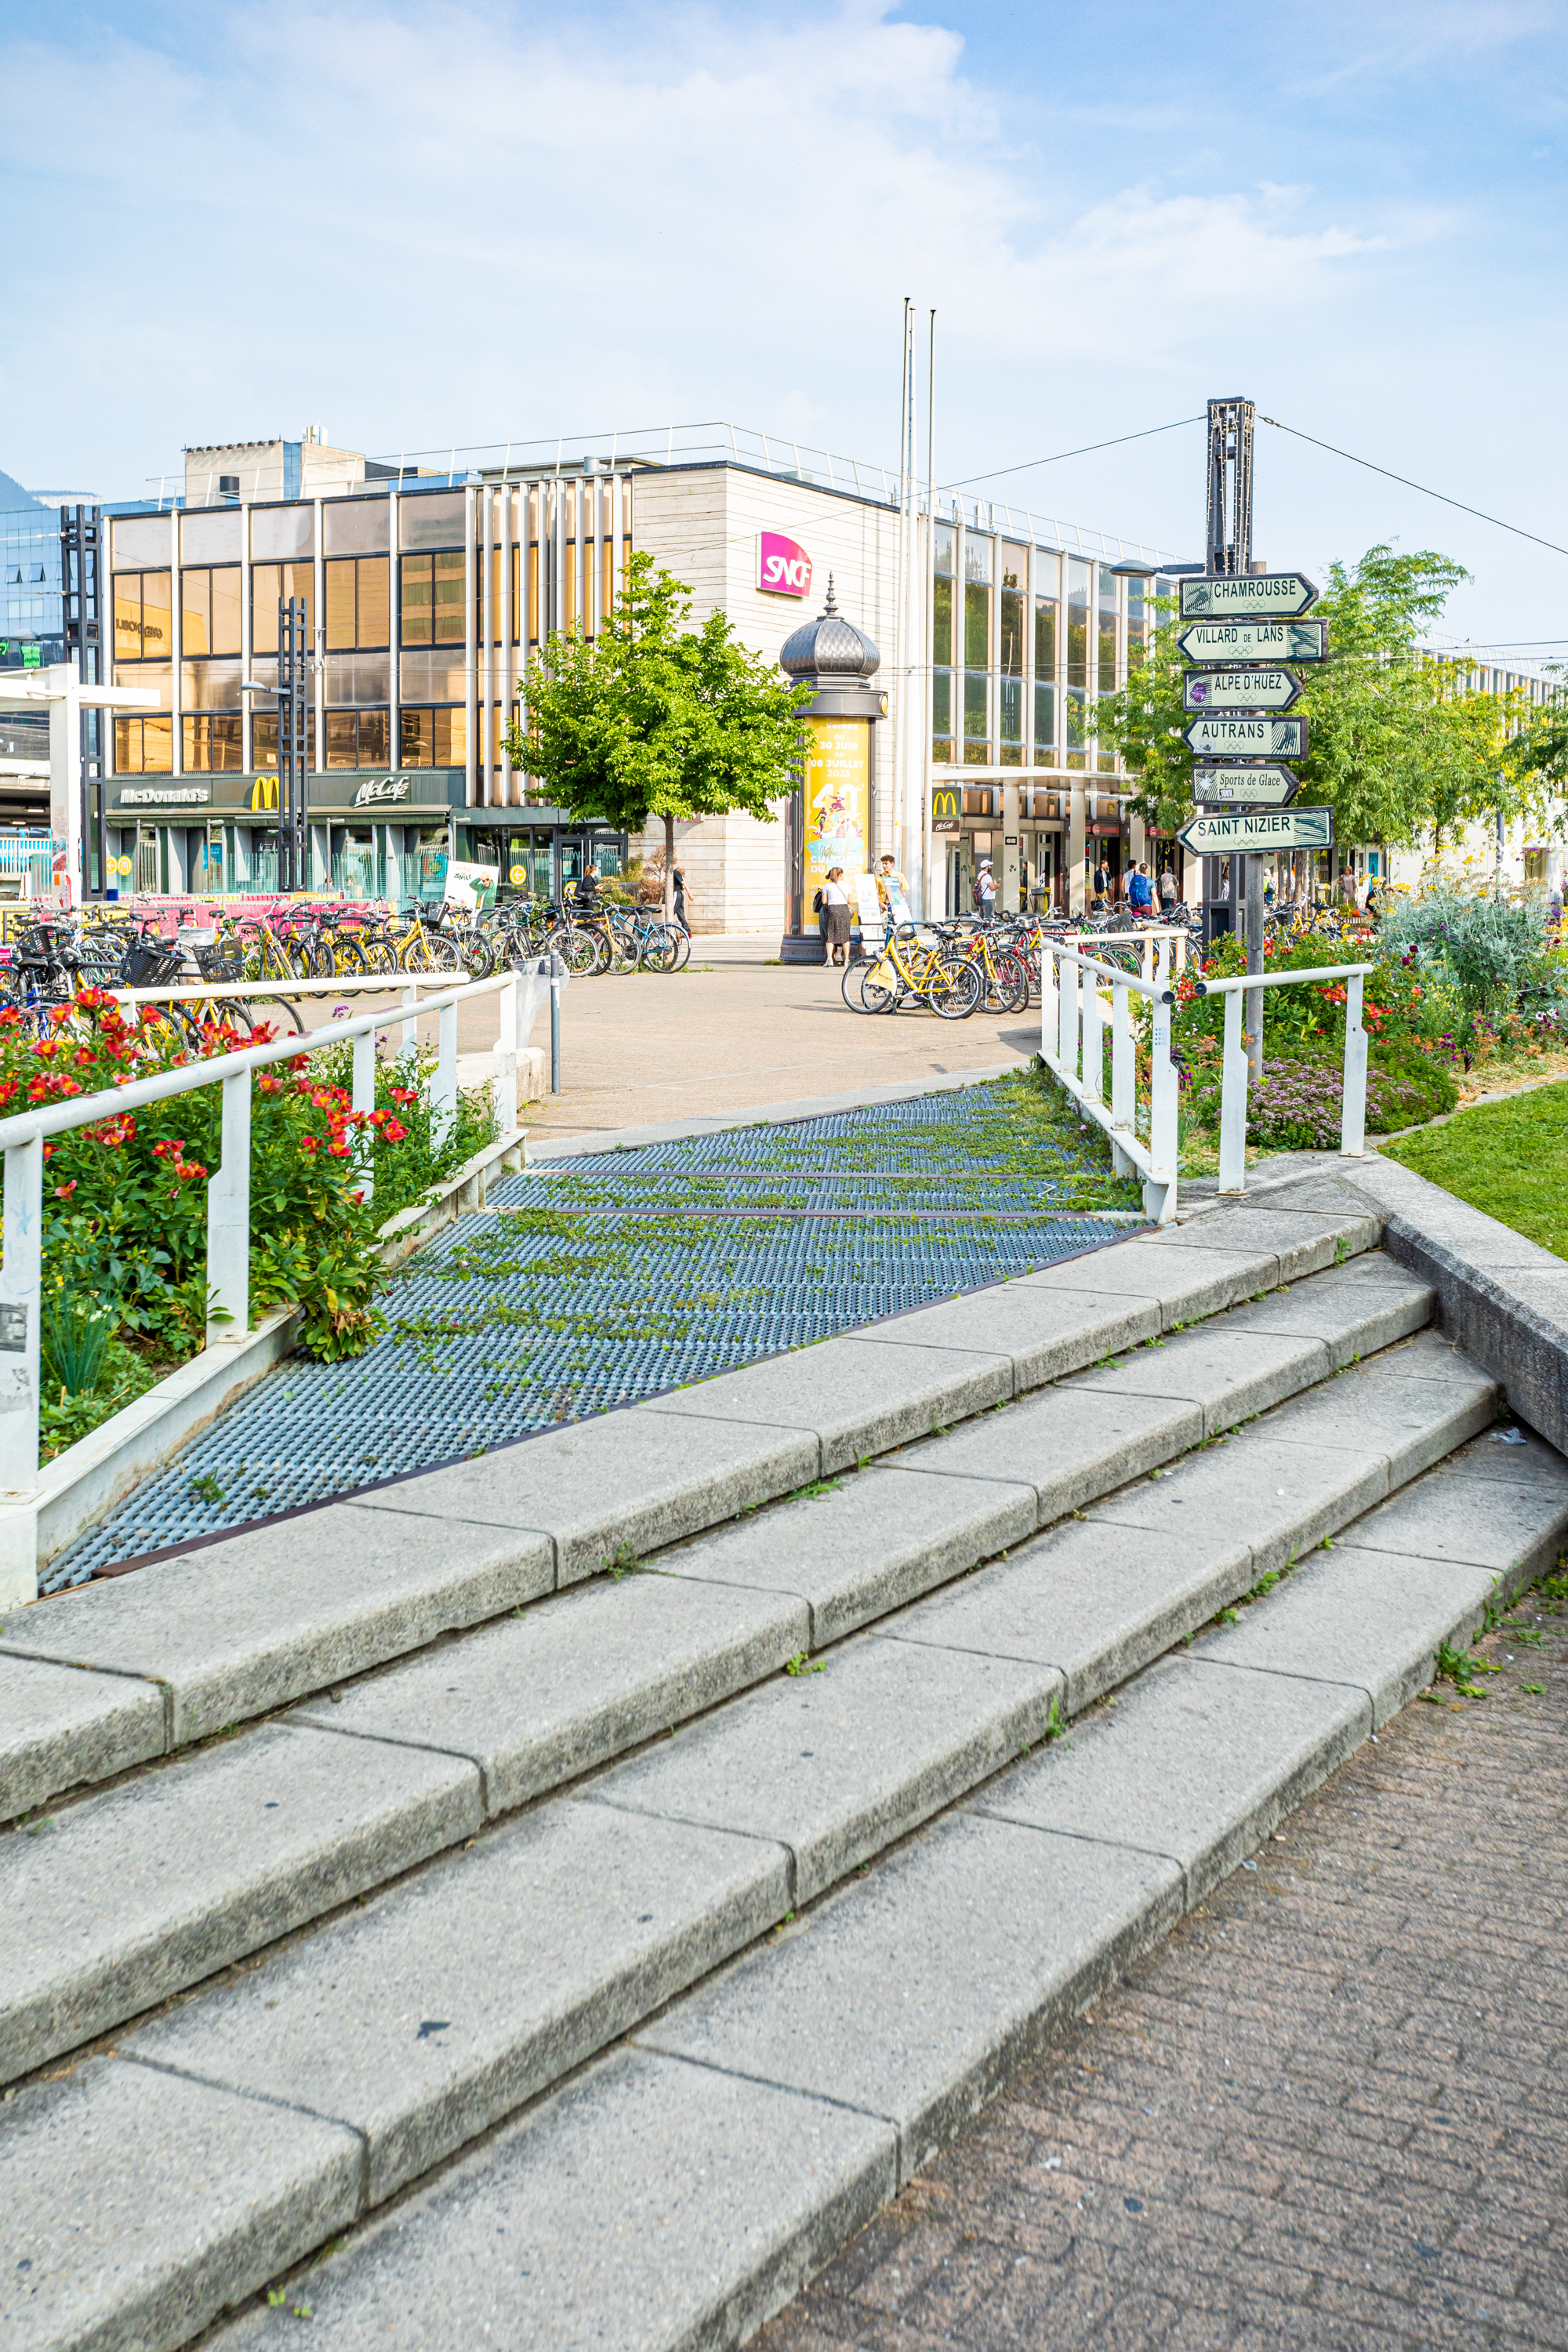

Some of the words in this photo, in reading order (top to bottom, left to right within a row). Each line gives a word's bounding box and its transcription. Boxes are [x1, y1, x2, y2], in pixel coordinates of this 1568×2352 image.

[763, 555, 811, 588] SNCF
[1214, 580, 1296, 597] CHAMROUSSE
[1196, 628, 1237, 643] VILLARD
[1243, 633, 1251, 642] DE
[1257, 626, 1283, 642] LANS
[1214, 676, 1241, 690] ALPE
[1244, 674, 1282, 689] D'HUEZ
[1202, 724, 1265, 738] AUTRANS
[811, 759, 823, 768] 08
[826, 760, 864, 768] JUILLET
[1220, 773, 1244, 787] Sports
[1247, 773, 1256, 786] de
[1259, 773, 1280, 786] Glace
[120, 789, 209, 804] McDonald's
[1198, 819, 1240, 836] SAINT
[1245, 816, 1290, 833] NIZIER
